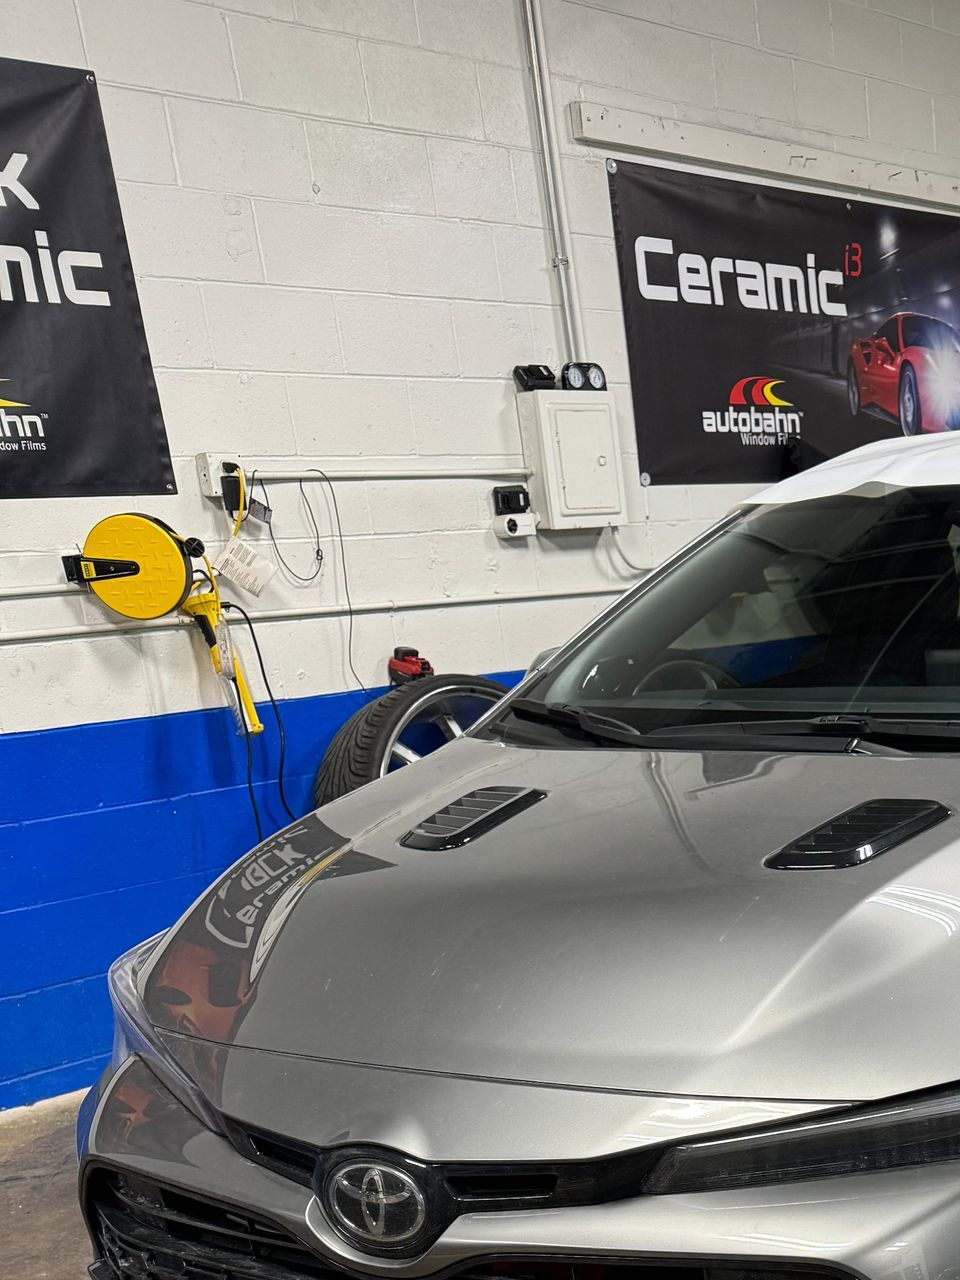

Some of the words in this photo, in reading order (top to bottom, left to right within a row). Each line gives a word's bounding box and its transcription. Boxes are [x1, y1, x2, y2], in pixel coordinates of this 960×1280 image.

[634, 235, 848, 317] Ceramic
[701, 406, 801, 433] autobahn
[21, 440, 47, 451] Films
[740, 432, 776, 446] Window
